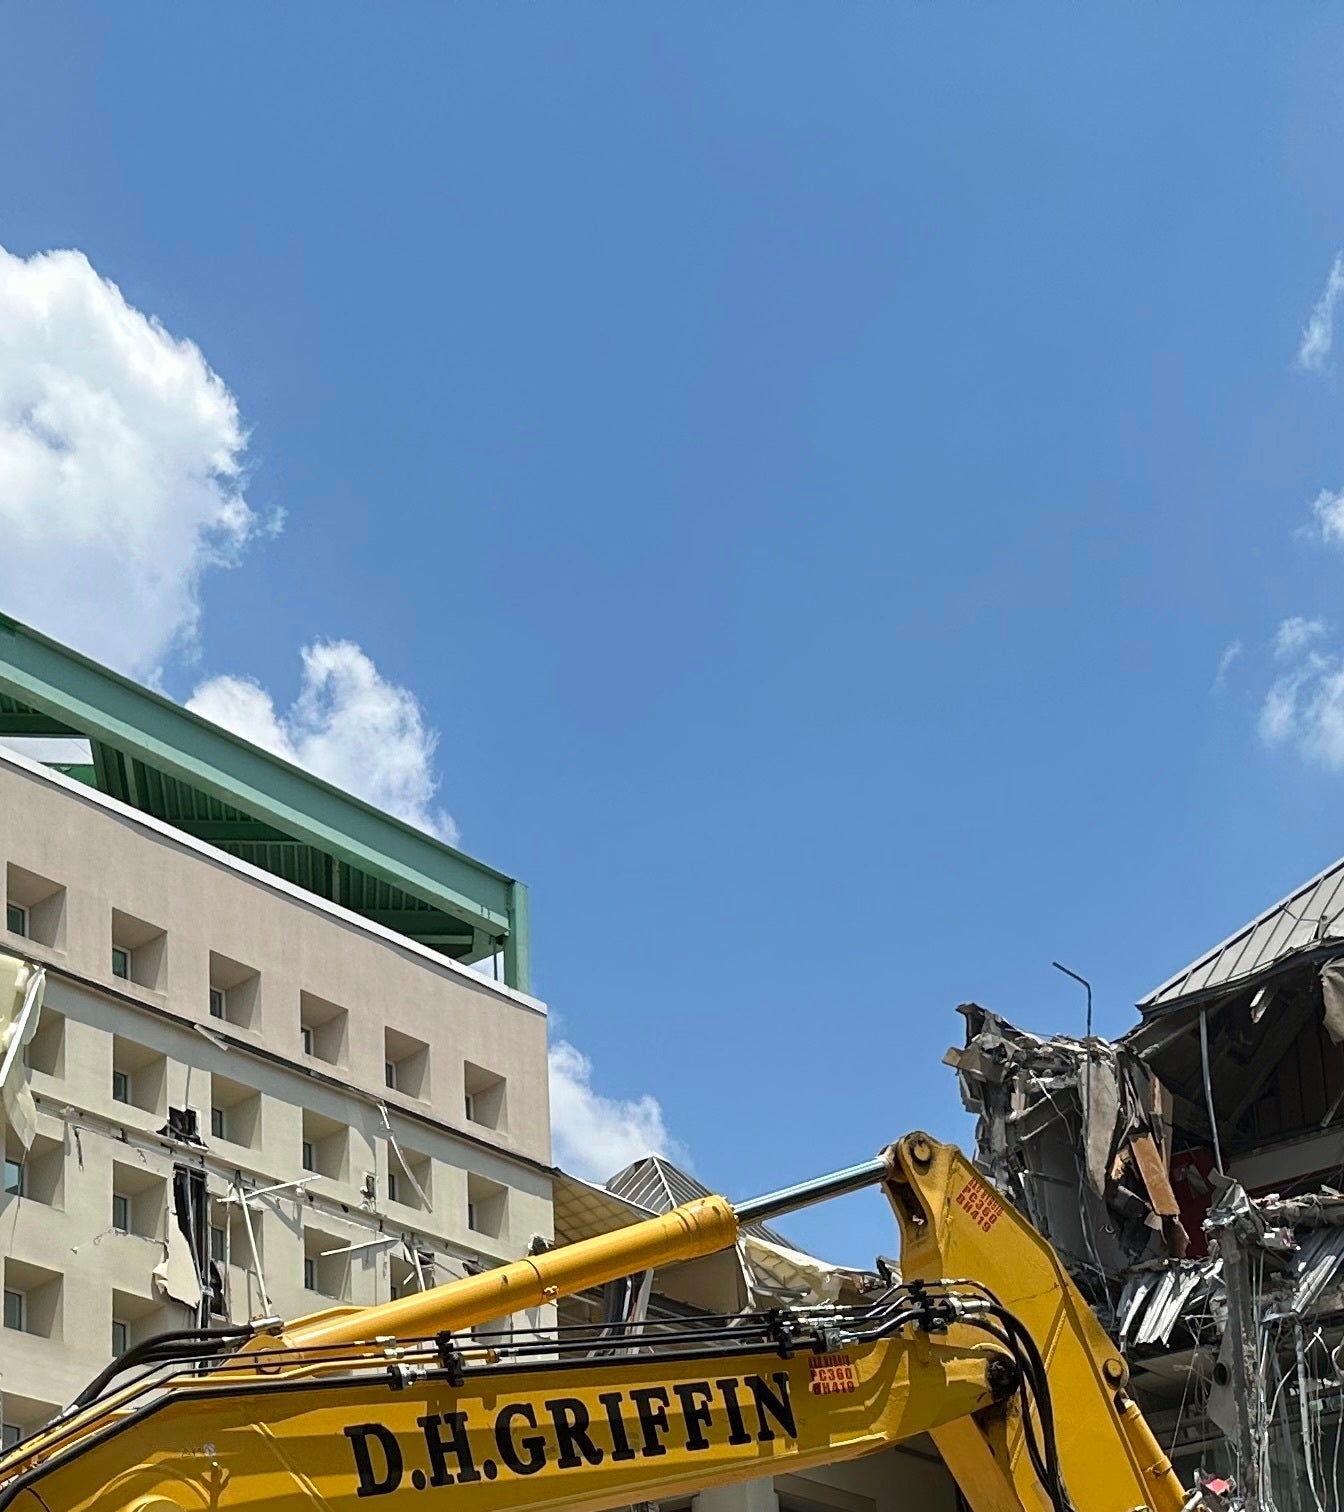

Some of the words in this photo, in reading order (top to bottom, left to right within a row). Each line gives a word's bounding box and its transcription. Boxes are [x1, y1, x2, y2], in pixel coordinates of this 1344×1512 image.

[956, 1193, 991, 1233] BH419
[962, 1184, 998, 1225] PC360
[810, 1367, 853, 1382] PC360
